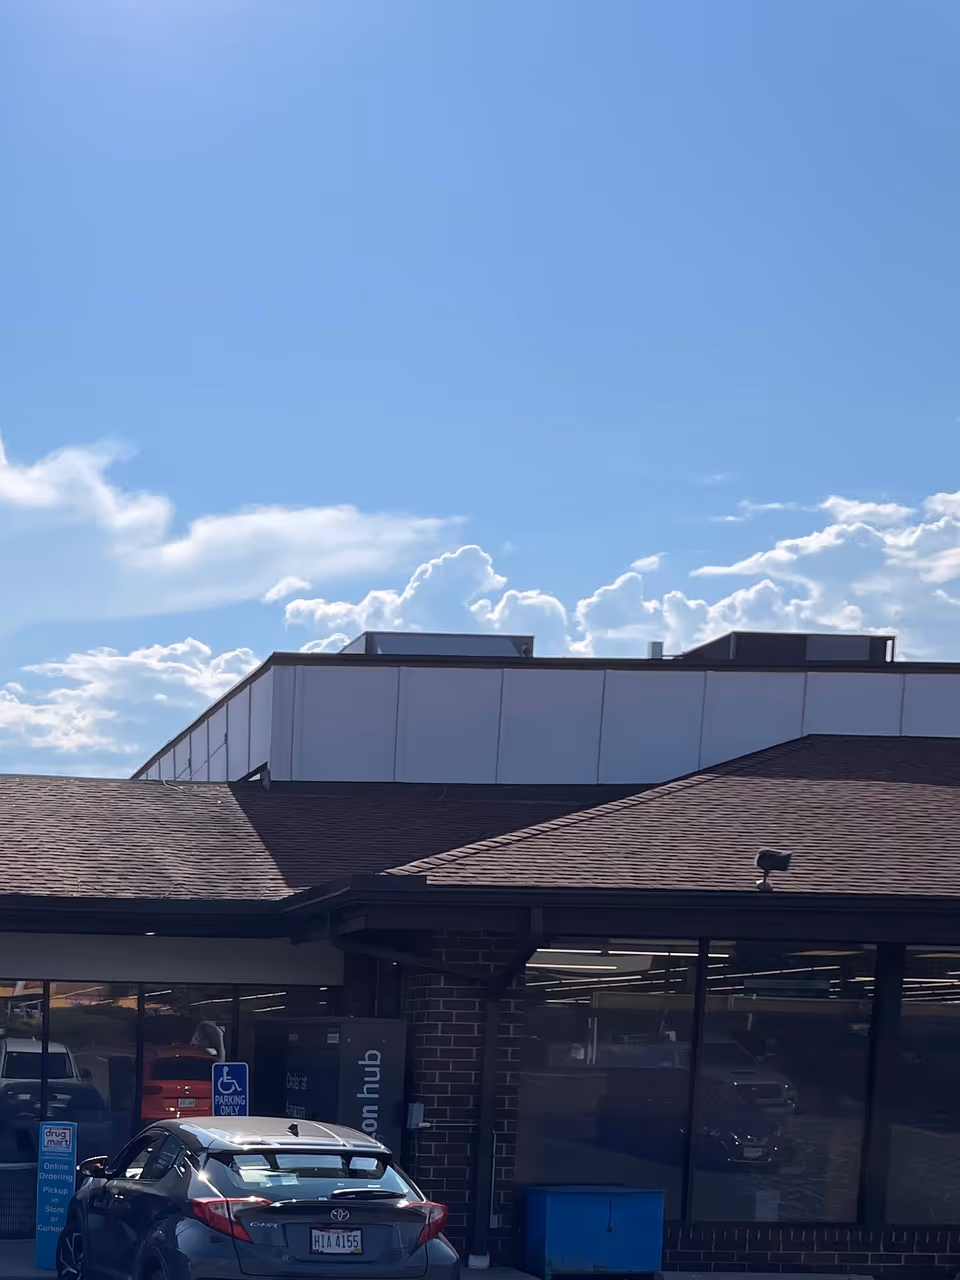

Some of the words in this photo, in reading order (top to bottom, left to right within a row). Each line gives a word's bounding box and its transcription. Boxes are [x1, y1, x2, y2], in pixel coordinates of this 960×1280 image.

[356, 1049, 382, 1099] hub
[214, 1094, 246, 1105] PARKING
[220, 1105, 240, 1116] ONLY
[45, 1127, 66, 1140] drug
[47, 1139, 70, 1147] mart
[44, 1162, 69, 1171] Online
[40, 1172, 73, 1182] Ordering
[43, 1186, 69, 1195] Pickup
[45, 1205, 65, 1213] Store
[335, 1234, 359, 1249] 4155
